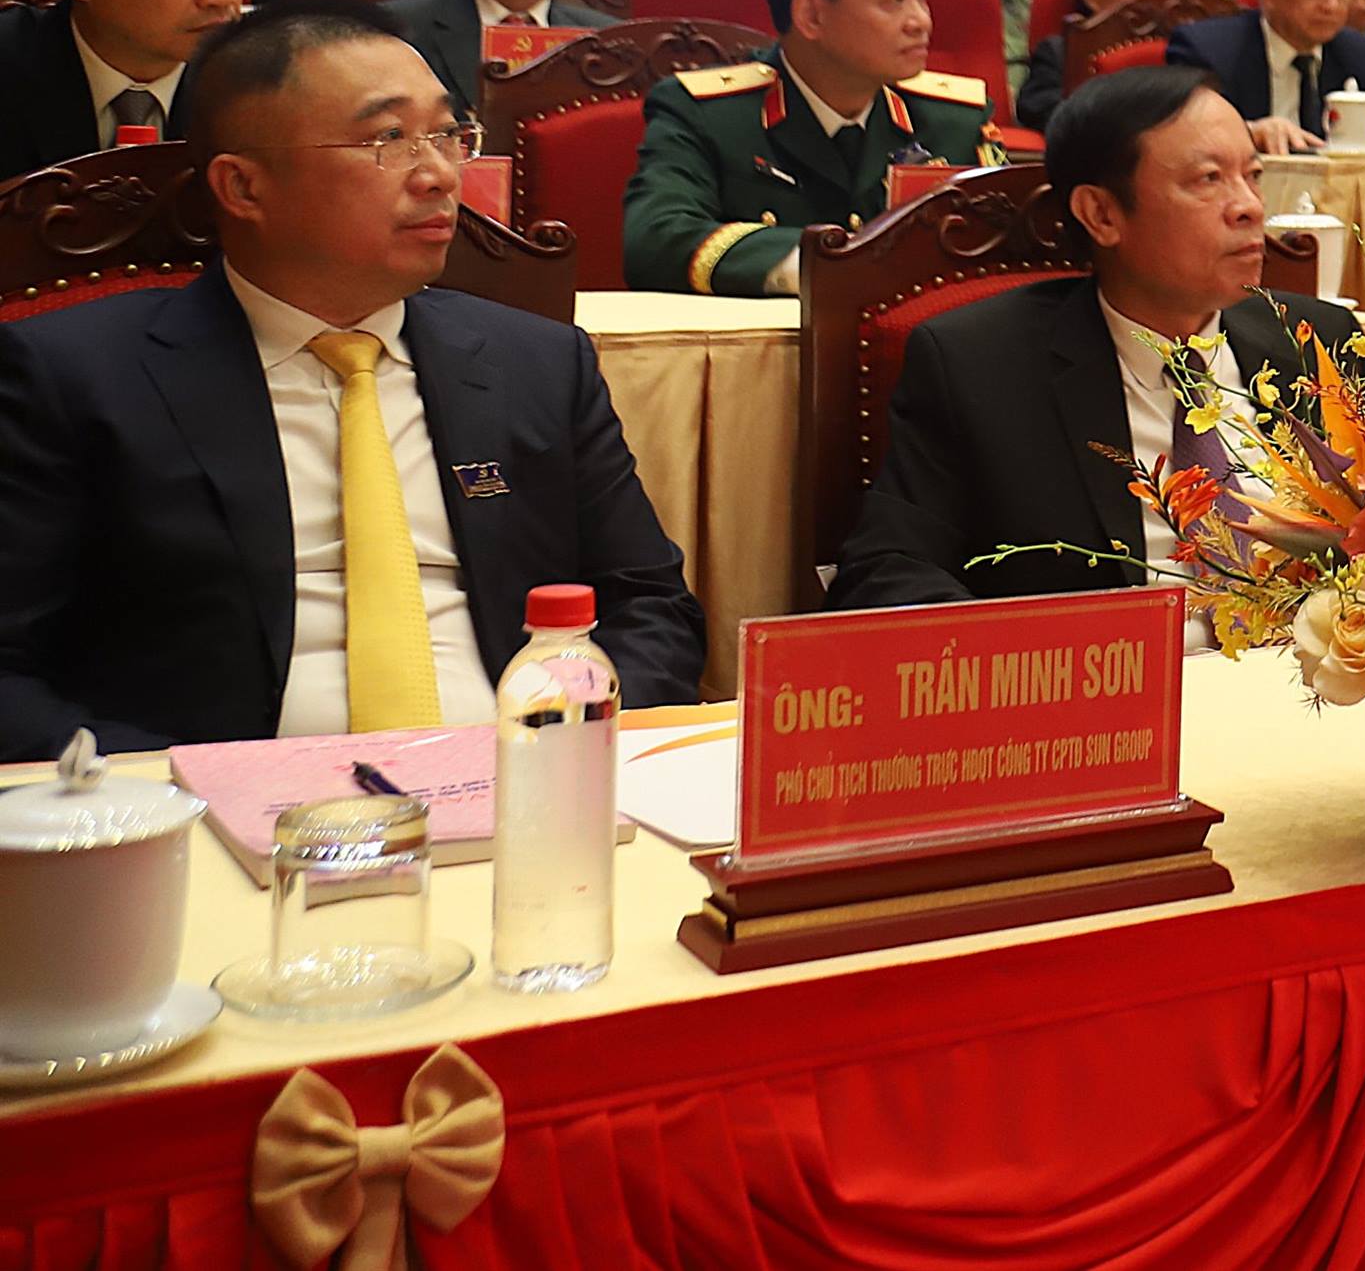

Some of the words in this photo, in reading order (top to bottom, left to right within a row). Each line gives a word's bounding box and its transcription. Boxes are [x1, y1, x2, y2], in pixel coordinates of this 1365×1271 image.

[773, 681, 864, 736] ÔNG:
[896, 637, 981, 720] TRẦN
[989, 646, 1074, 710] MINH
[1082, 637, 1145, 700] SƠN
[776, 761, 804, 806] PHÓ
[807, 750, 835, 802] CHỦ
[838, 759, 869, 807] TỊCH
[996, 737, 1032, 779] CÔNG
[1034, 739, 1050, 774] TY
[1085, 730, 1112, 767] SUN
[1114, 727, 1153, 764] GROUP
